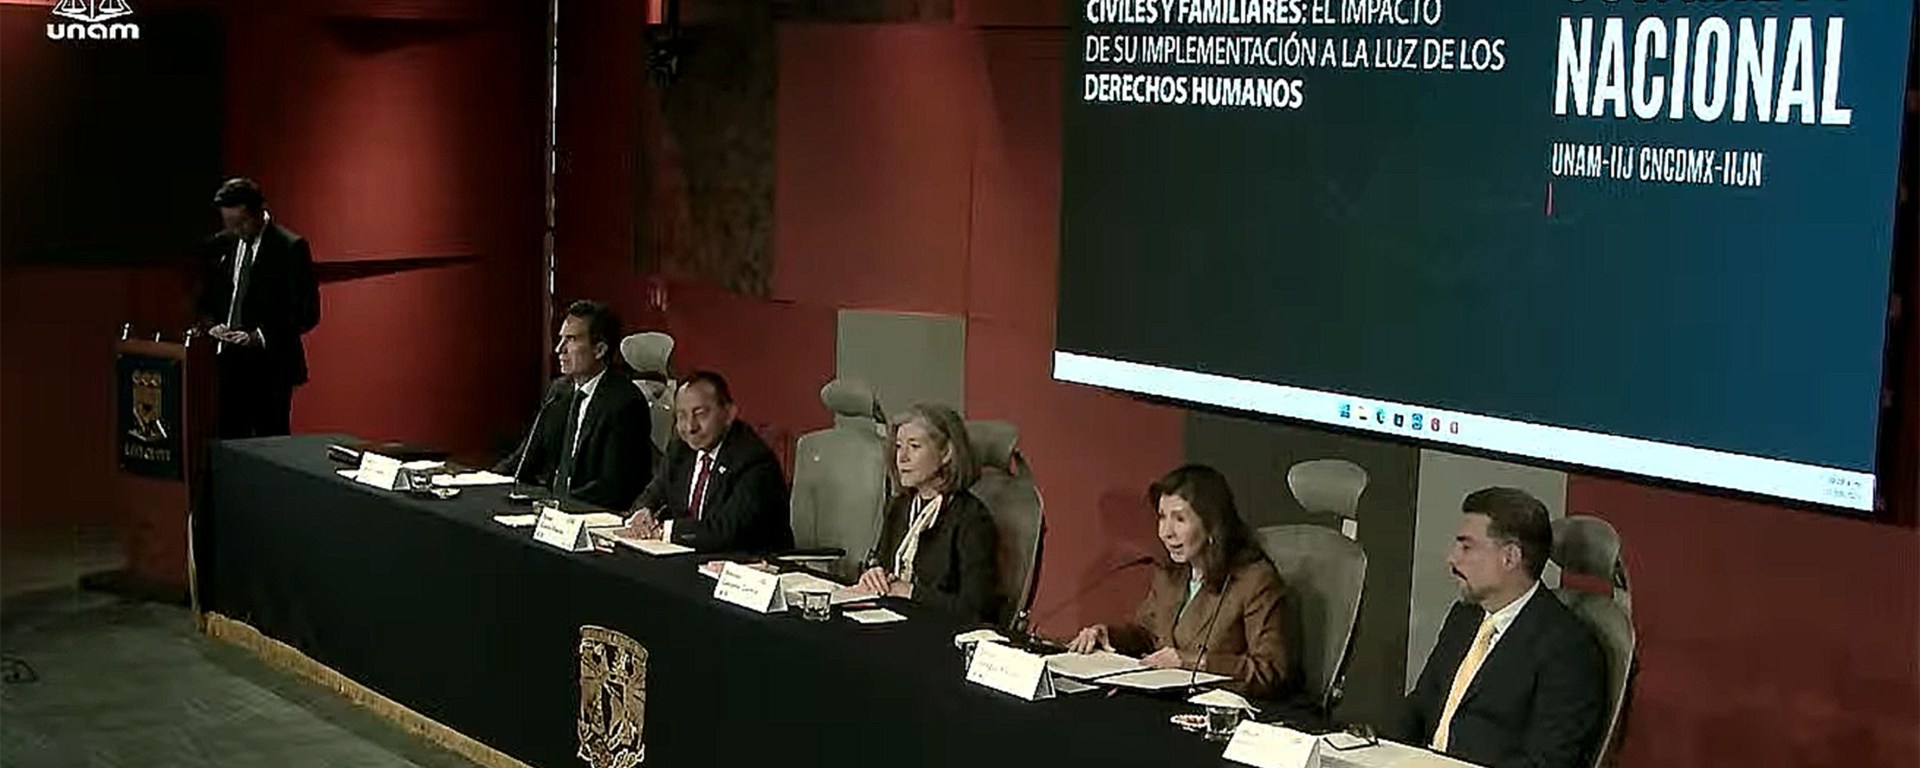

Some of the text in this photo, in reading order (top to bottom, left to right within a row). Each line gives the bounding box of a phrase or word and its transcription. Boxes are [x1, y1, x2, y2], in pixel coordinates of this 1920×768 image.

[1086, 0, 1442, 25] CIVILES Y FAMILIARES: EL IMPACTO
[1086, 31, 1506, 71] DE SU IMPLEMENTACIÓN A LA LUZ DE LOS
[1554, 16, 1852, 125] NACIONAL
[1084, 73, 1304, 109] DERECHOS HUMANOS
[1551, 142, 1635, 180] UNAM-IIJ
